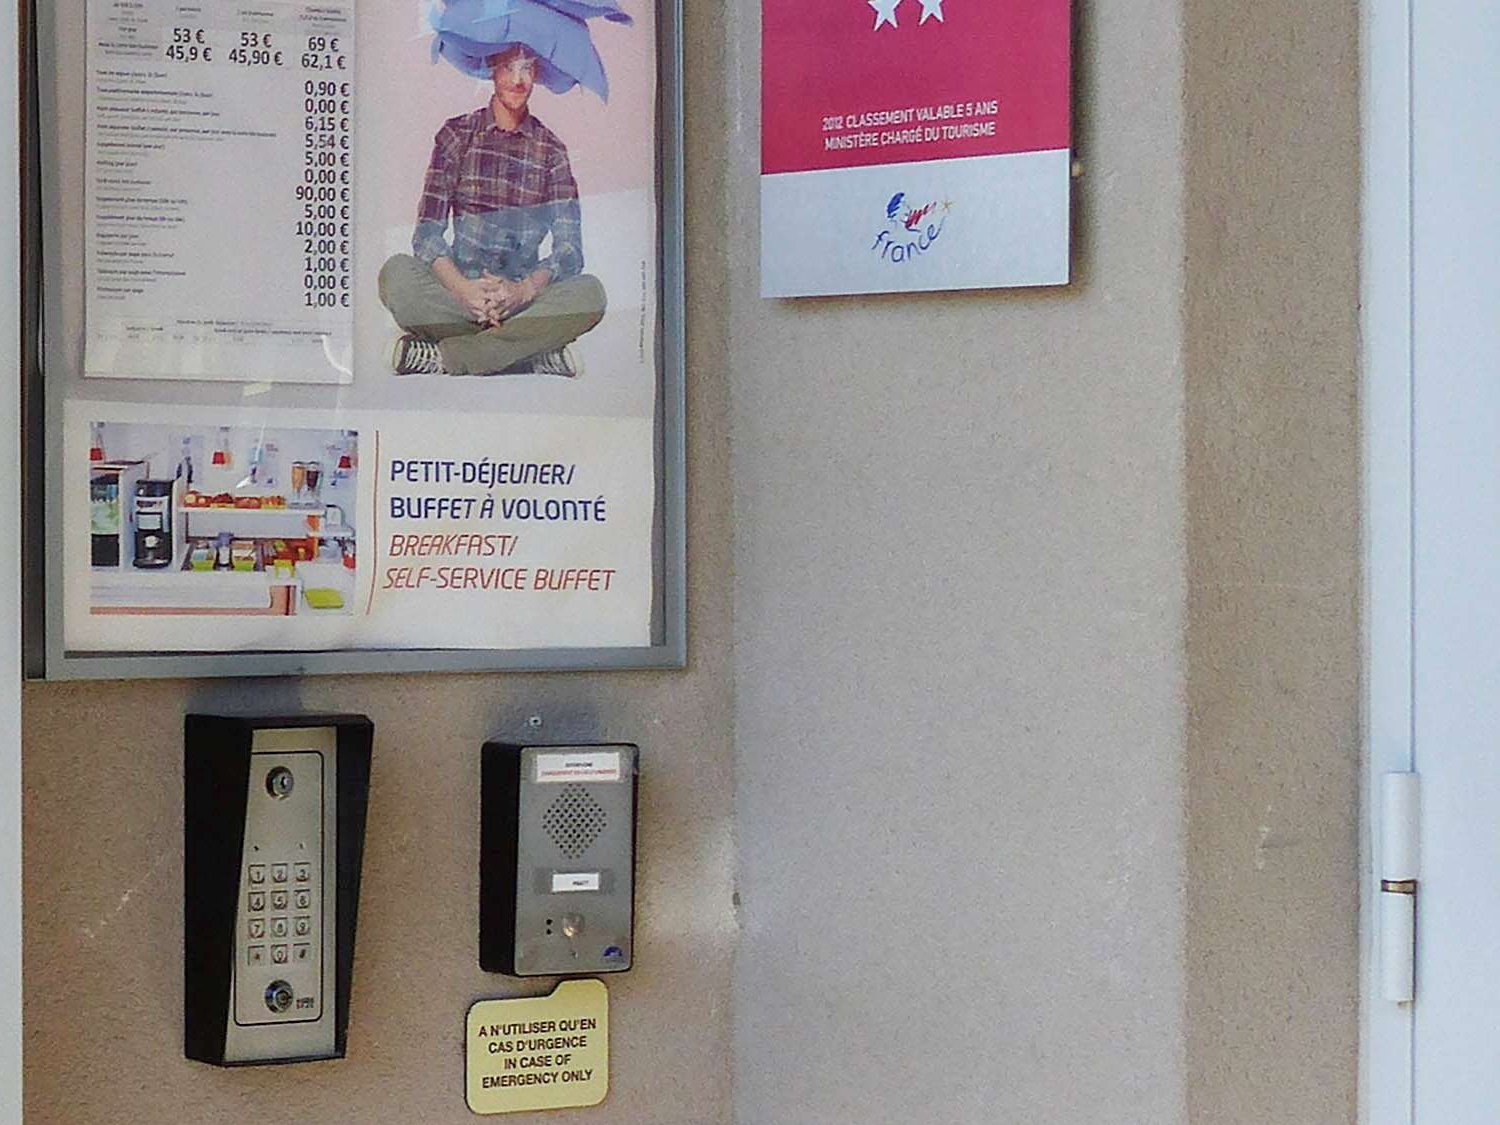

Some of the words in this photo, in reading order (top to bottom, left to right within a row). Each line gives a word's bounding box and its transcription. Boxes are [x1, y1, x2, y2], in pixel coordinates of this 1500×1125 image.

[172, 28, 192, 43] 53
[195, 29, 205, 44] €
[241, 32, 259, 47] 53
[262, 33, 272, 48] €
[308, 36, 326, 52] 69
[330, 38, 340, 52] €
[165, 45, 198, 63] 45,9
[202, 47, 213, 62] €
[229, 48, 270, 66] 45,90
[274, 51, 284, 66] €
[301, 53, 333, 71] 62,1
[337, 55, 347, 70] €
[304, 80, 336, 98] 0,90
[339, 81, 350, 97] €
[304, 98, 336, 115] 0,00
[339, 99, 350, 114] €
[822, 115, 844, 131] 2012
[846, 108, 914, 129] CLASSEMENT
[916, 104, 965, 120] VALABLE
[966, 103, 973, 116] 5
[975, 100, 998, 115] ANS
[304, 116, 336, 133] 6,15
[339, 117, 350, 132] €
[304, 134, 336, 151] 5,54
[339, 135, 350, 150] €
[824, 131, 879, 150] MINISTÈRE
[880, 126, 923, 145] CHARGÉ
[925, 127, 940, 141] DU
[941, 121, 996, 139] TOURISME
[304, 152, 336, 168] 5,00
[339, 152, 350, 167] €
[304, 169, 336, 186] 0,00
[339, 170, 350, 185] €
[295, 187, 336, 203] 90,00
[339, 188, 350, 202] €
[304, 205, 336, 221] 5,00
[339, 205, 350, 220] €
[295, 222, 336, 239] 10,00
[339, 223, 350, 238] €
[304, 240, 336, 256] 2,00
[339, 240, 350, 255] €
[304, 257, 336, 274] 1,00
[339, 258, 350, 273] €
[304, 275, 336, 291] 0,00
[339, 276, 350, 290] €
[304, 292, 336, 309] 1,00
[339, 293, 350, 308] €
[390, 496, 477, 520] BUFFET
[479, 493, 495, 520] À
[501, 495, 607, 522] VOLONTÉ
[388, 534, 519, 557] BREAKFAST/
[382, 566, 528, 590] SELF-SERVICE
[533, 568, 616, 591] BUFFET
[478, 1026, 487, 1037] A
[488, 1041, 514, 1054] CAS
[504, 1058, 517, 1070] IN
[519, 1055, 552, 1069] CASE
[554, 1054, 572, 1065] OF
[482, 1072, 559, 1089] EMERGENCY
[561, 1068, 594, 1082] ONLY
